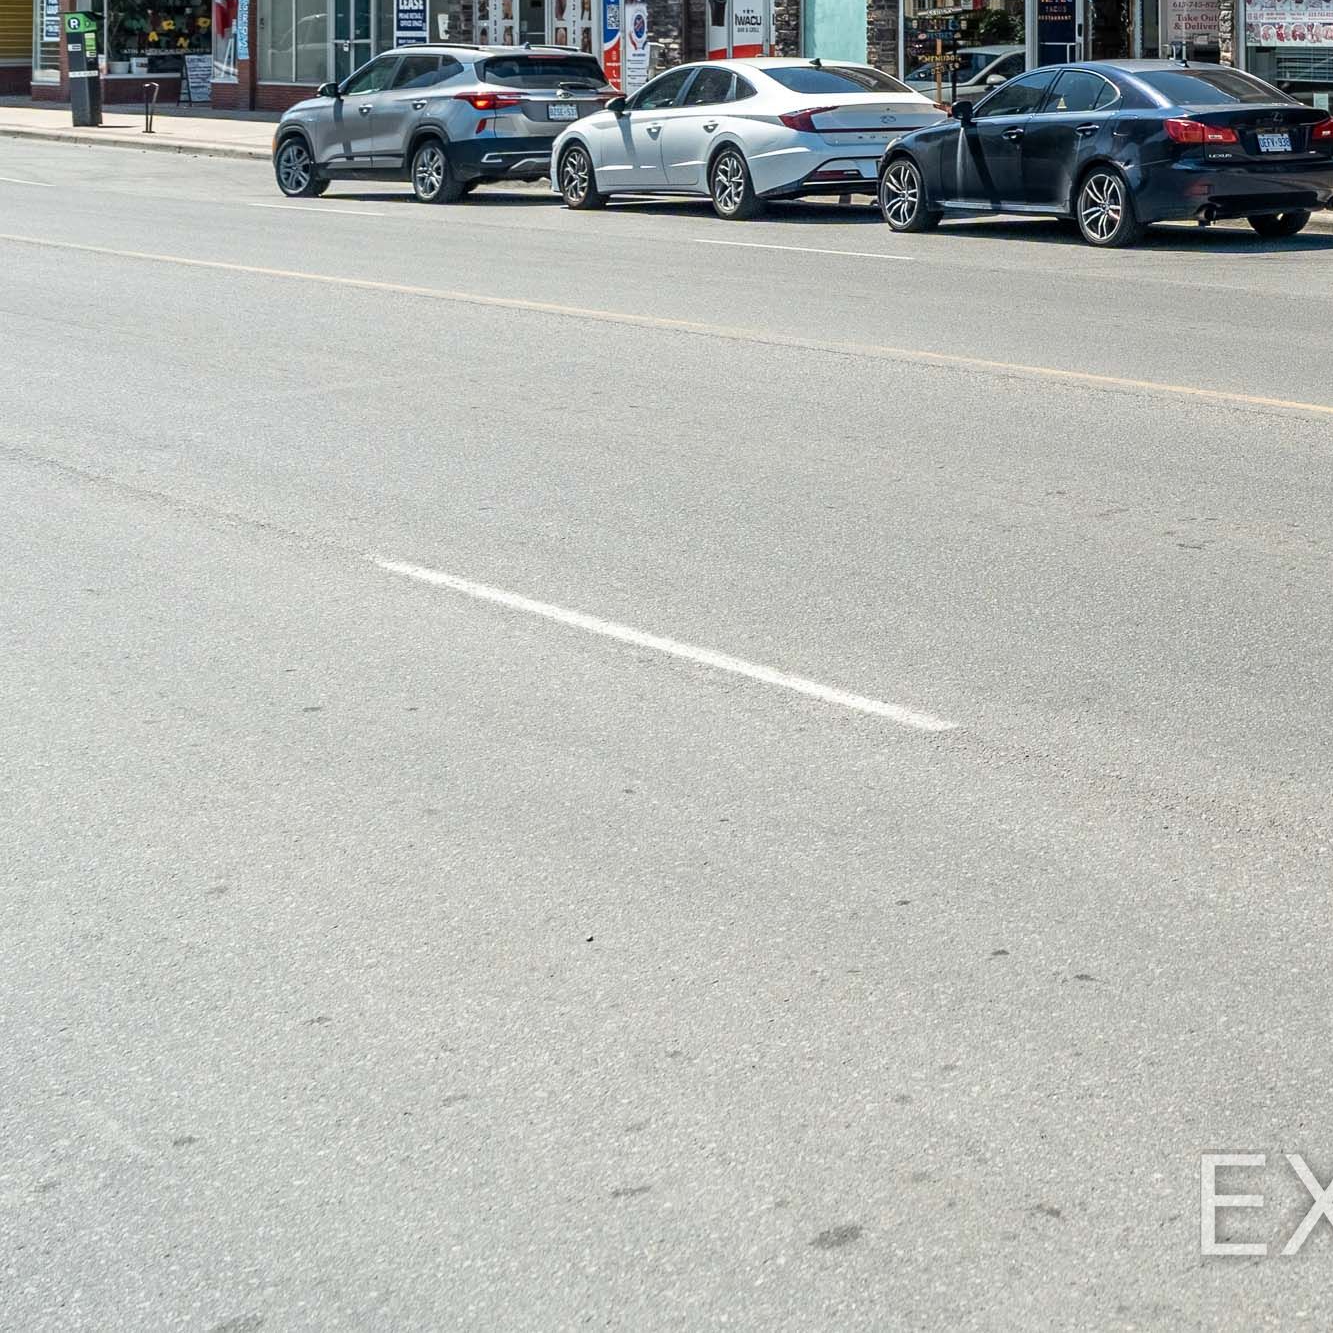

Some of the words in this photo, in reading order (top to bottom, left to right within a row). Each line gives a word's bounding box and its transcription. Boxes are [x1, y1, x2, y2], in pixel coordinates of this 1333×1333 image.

[735, 14, 762, 26] IWACU
[1177, 14, 1198, 22] Take
[1185, 22, 1217, 30] Deliver
